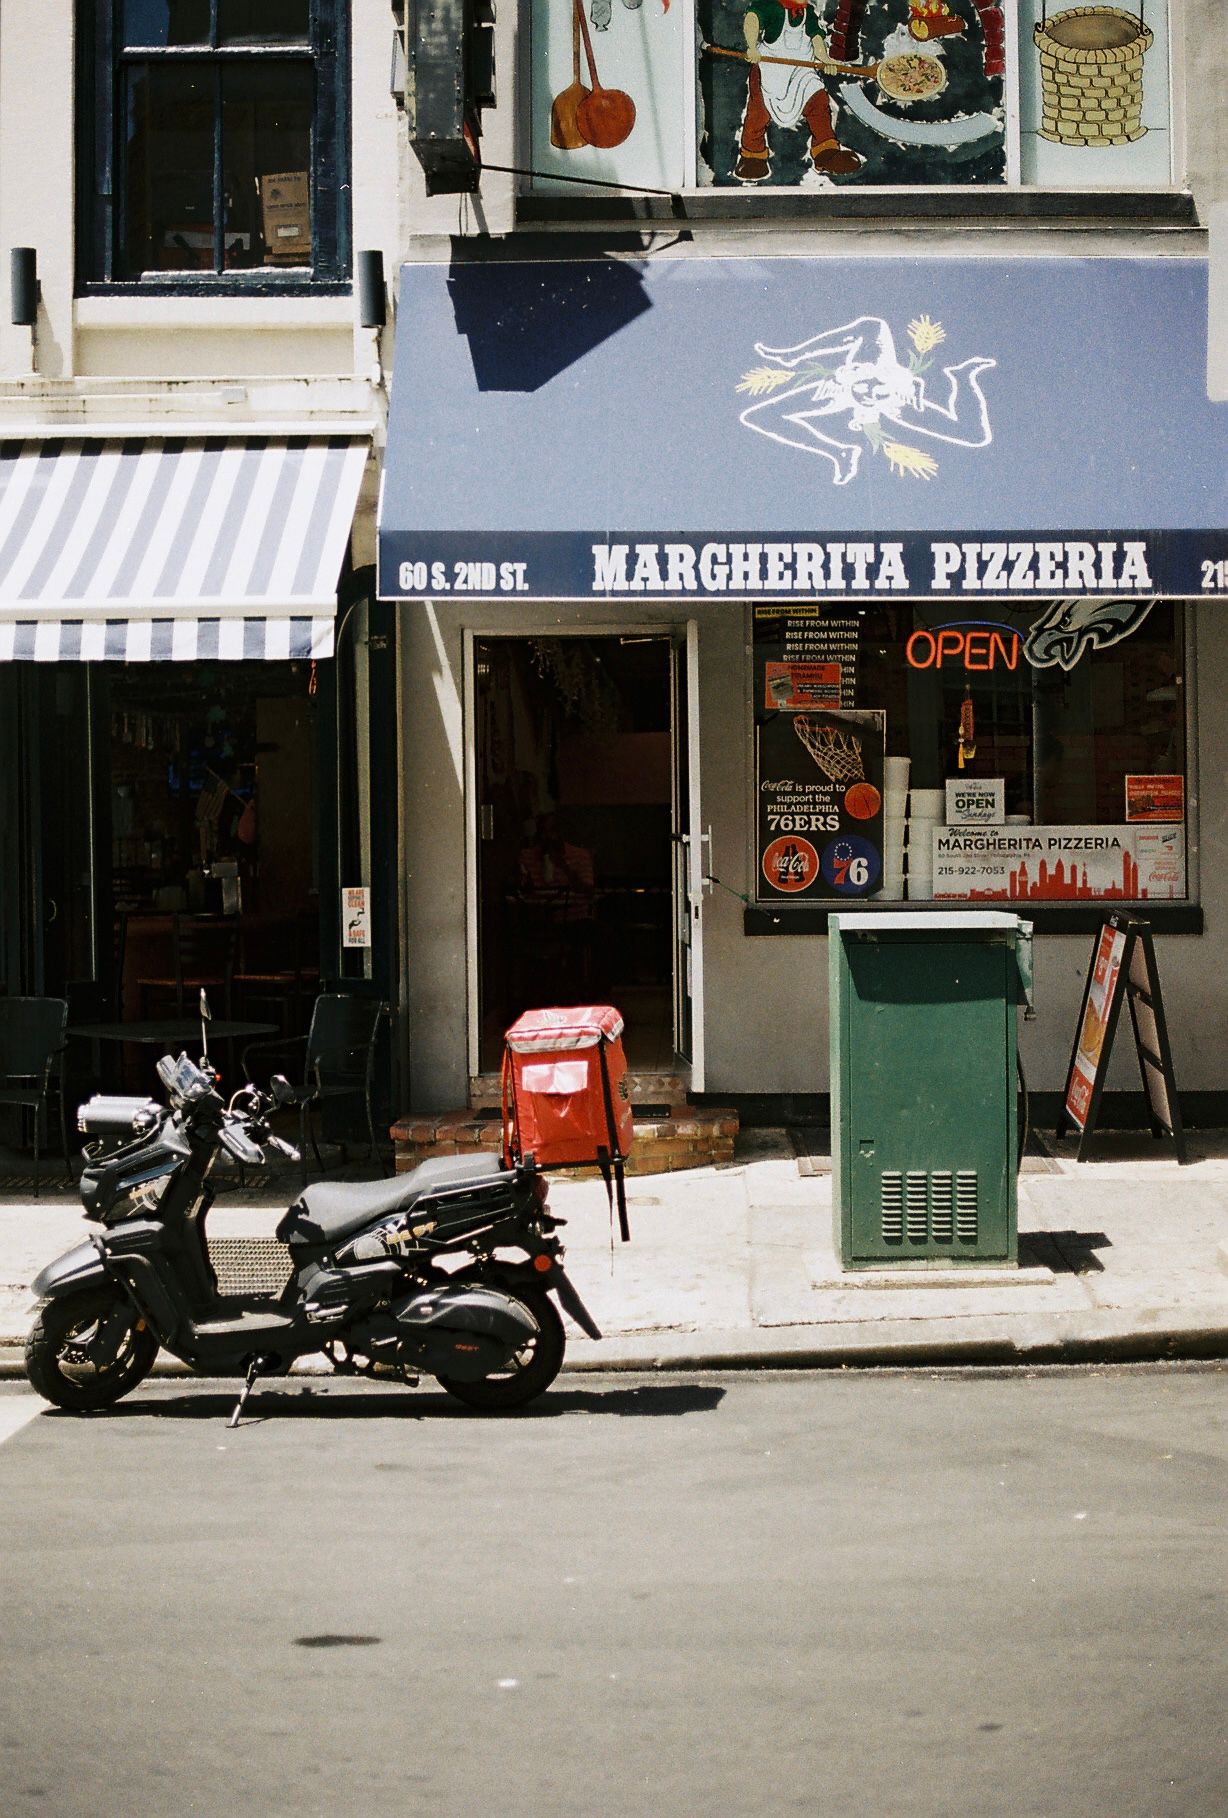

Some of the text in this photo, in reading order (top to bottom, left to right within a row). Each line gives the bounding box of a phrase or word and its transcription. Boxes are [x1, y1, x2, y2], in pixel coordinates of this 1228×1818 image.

[592, 542, 1153, 591] MARGHERITA PIZZERIA
[399, 561, 530, 591] 60 S. 2ND ST.
[757, 608, 771, 616] RISE
[787, 620, 860, 628] RISE FROM WITHIN
[785, 631, 858, 639] RISE FROM WITHIN
[786, 643, 858, 651] RISE FROM WITHIN
[906, 630, 1019, 670] OPEN
[783, 654, 856, 662] RISE FROM WITHIN
[796, 784, 803, 792] is
[805, 783, 834, 793] proud
[836, 784, 846, 792] to
[776, 794, 831, 803] support the
[955, 798, 996, 809] OPEN
[767, 804, 840, 813] PHILADELPHIA
[767, 814, 840, 831] 76ERS
[948, 828, 999, 837] Welcome to
[938, 837, 1121, 851] MARGHERITA PIZZERIA
[833, 857, 869, 886] 76
[938, 866, 1006, 876] 215-922-7053
